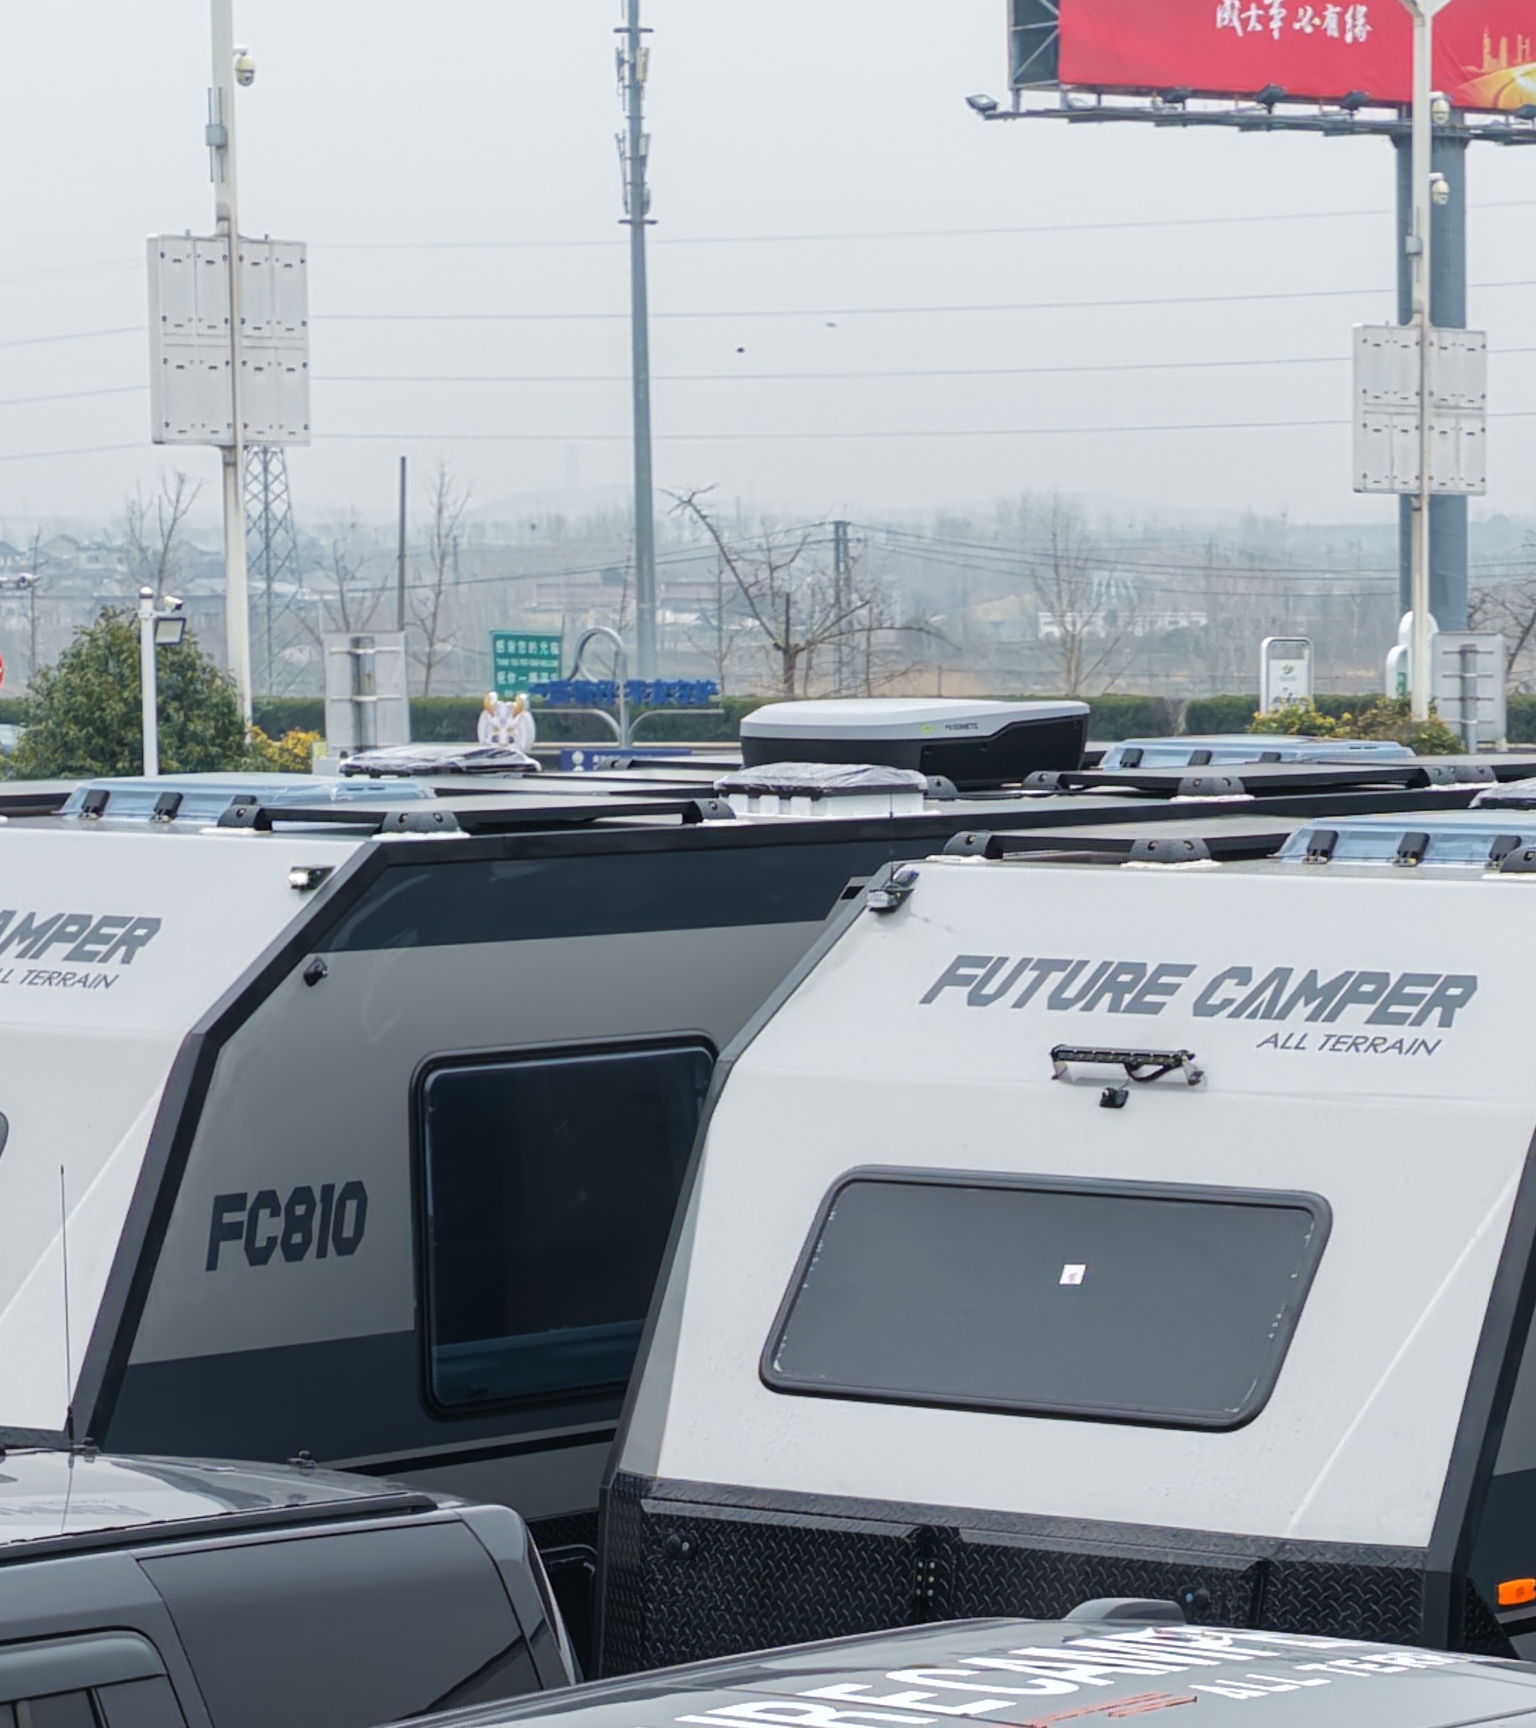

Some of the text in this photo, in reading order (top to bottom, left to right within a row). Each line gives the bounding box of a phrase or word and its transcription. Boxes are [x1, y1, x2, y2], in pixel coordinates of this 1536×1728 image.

[19, 969, 121, 991] TERRAIN
[919, 954, 1478, 1028] FUTURE CAMPER
[1256, 1032, 1442, 1058] ALL TERRAIN
[205, 1180, 368, 1272] FC810
